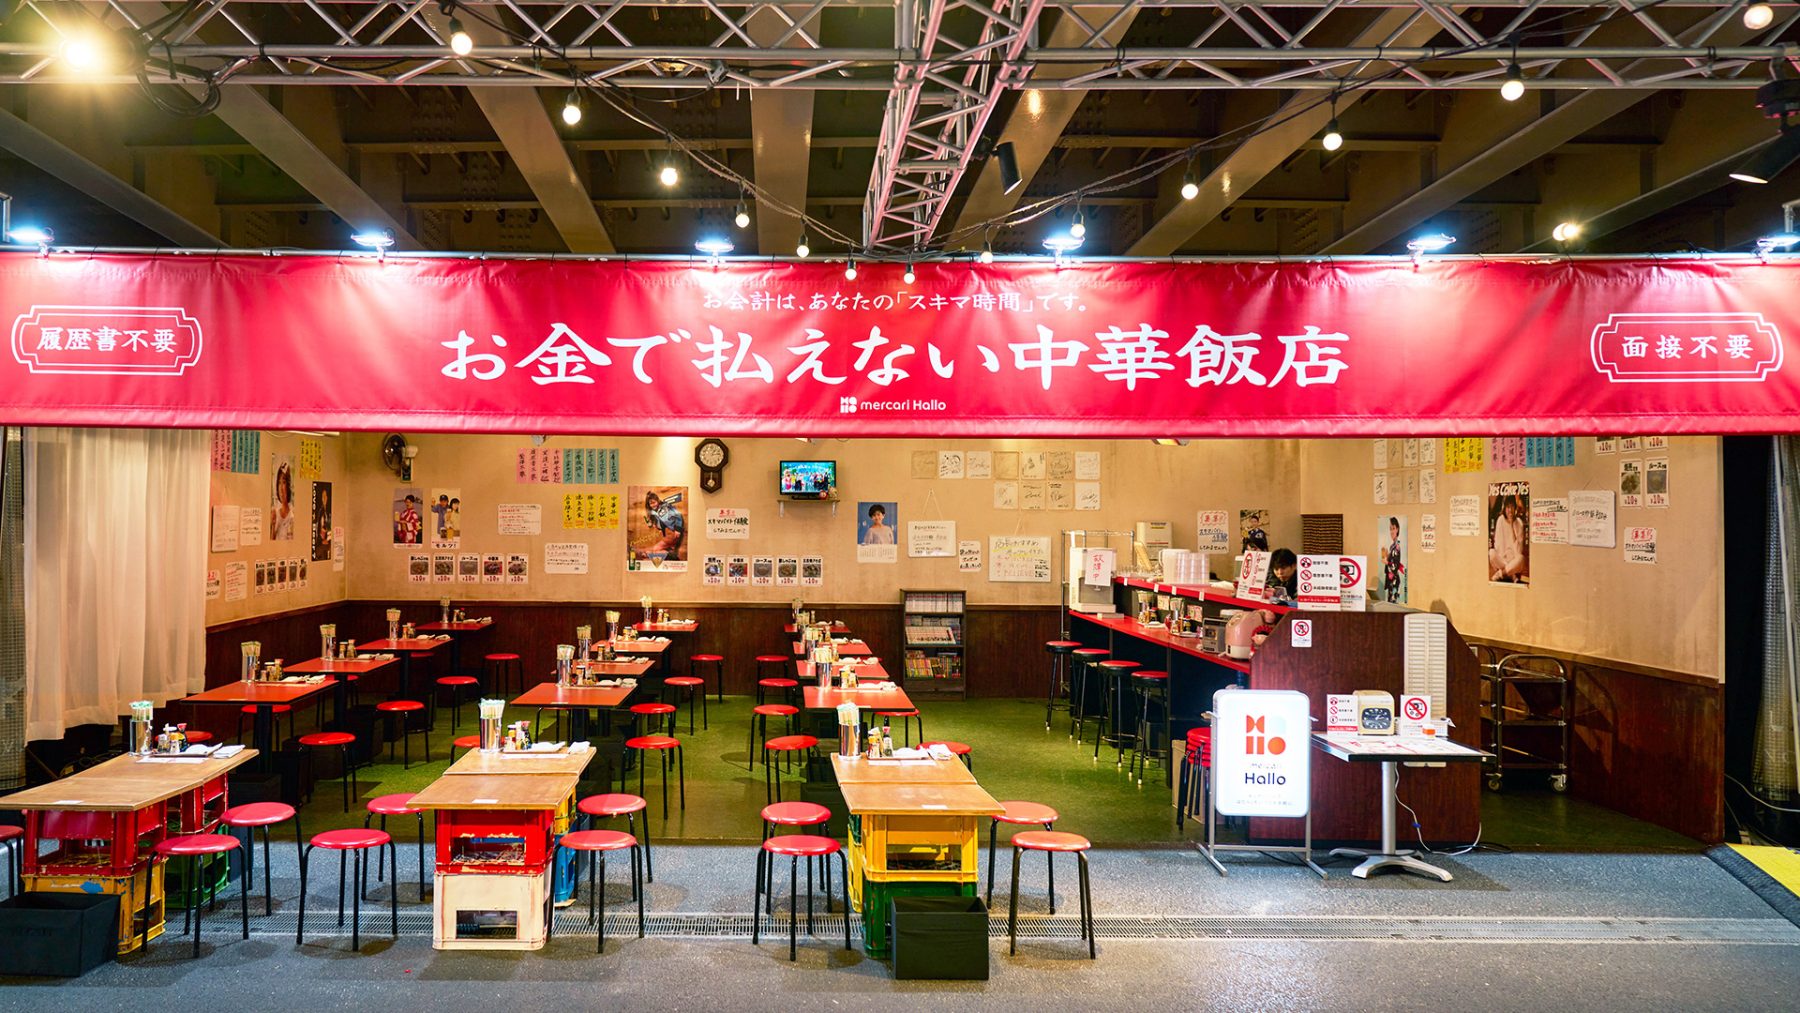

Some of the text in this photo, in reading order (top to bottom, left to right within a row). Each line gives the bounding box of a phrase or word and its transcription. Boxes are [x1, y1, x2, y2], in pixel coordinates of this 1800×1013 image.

[702, 291, 1087, 313] お会計は、あなたの「スキマ時間」です。
[37, 326, 177, 353] 履歴書不要
[1621, 334, 1754, 359] 面接不要
[440, 322, 1350, 391] お金で払えない中華飯店
[860, 399, 947, 411] mercari Hallo
[1489, 482, 1529, 497] Yes Coke Yes
[1244, 772, 1287, 786] Hallo
